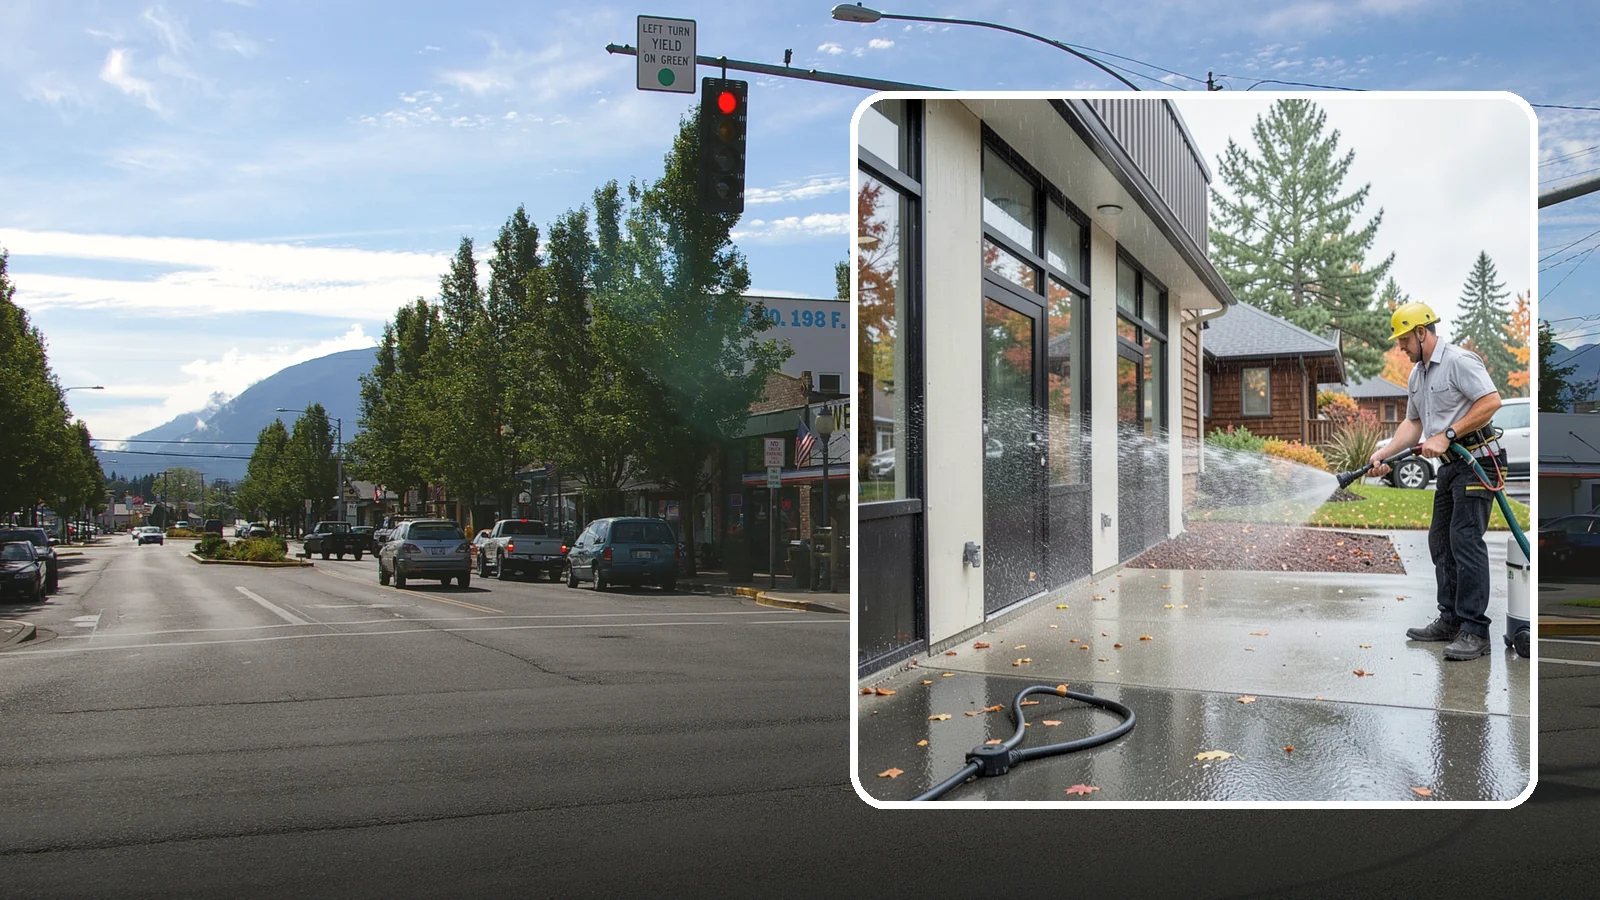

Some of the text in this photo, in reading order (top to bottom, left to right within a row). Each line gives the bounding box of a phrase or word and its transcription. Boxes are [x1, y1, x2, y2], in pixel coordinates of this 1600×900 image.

[643, 24, 690, 36] LEFT TURN
[652, 38, 682, 51] YIELD
[644, 53, 688, 66] ON GREEN
[791, 310, 826, 328] 198
[831, 311, 847, 329] F.
